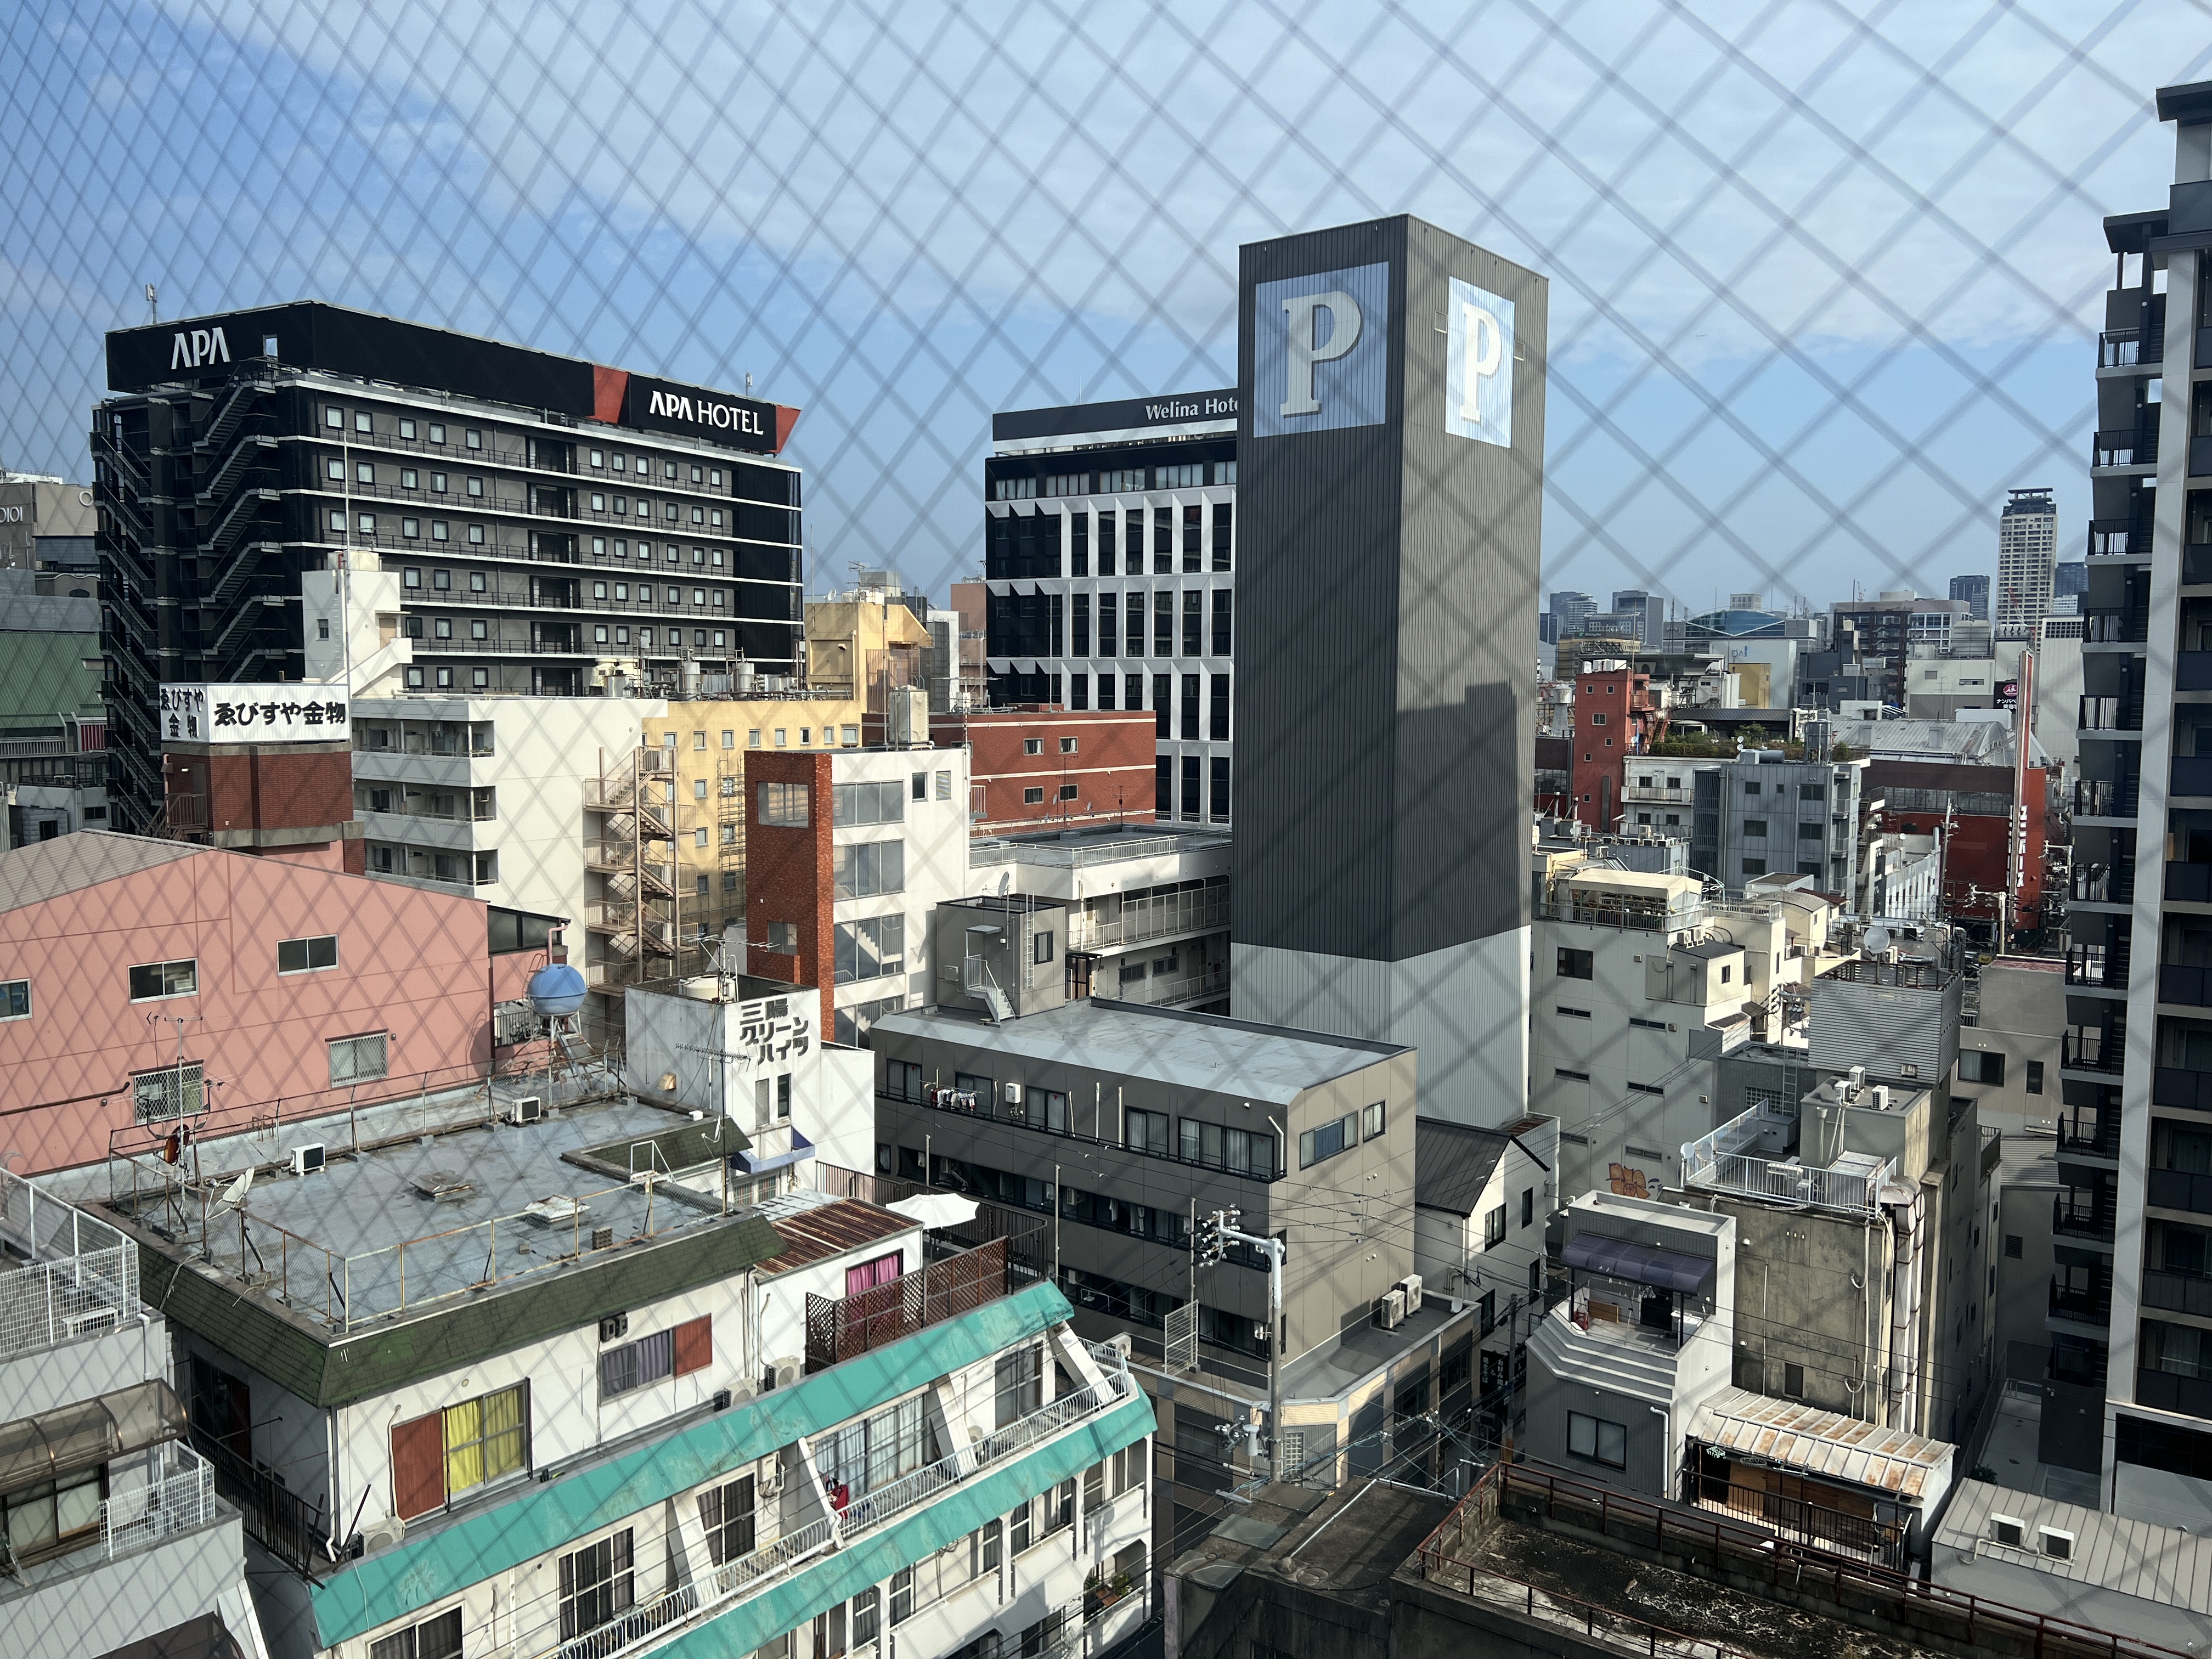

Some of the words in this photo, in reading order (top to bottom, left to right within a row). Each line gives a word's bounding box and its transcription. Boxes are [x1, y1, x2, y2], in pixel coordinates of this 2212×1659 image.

[171, 327, 230, 370] APA
[1280, 291, 1364, 419] P
[1460, 301, 1502, 426] P
[650, 390, 693, 422] APA
[697, 399, 764, 435] HOTEL
[1145, 401, 1199, 421] Welina
[161, 688, 206, 712] ゑびすや
[214, 700, 346, 726] ゑびすや金物
[168, 713, 199, 738] 金物
[758, 1036, 809, 1065] ハイツ
